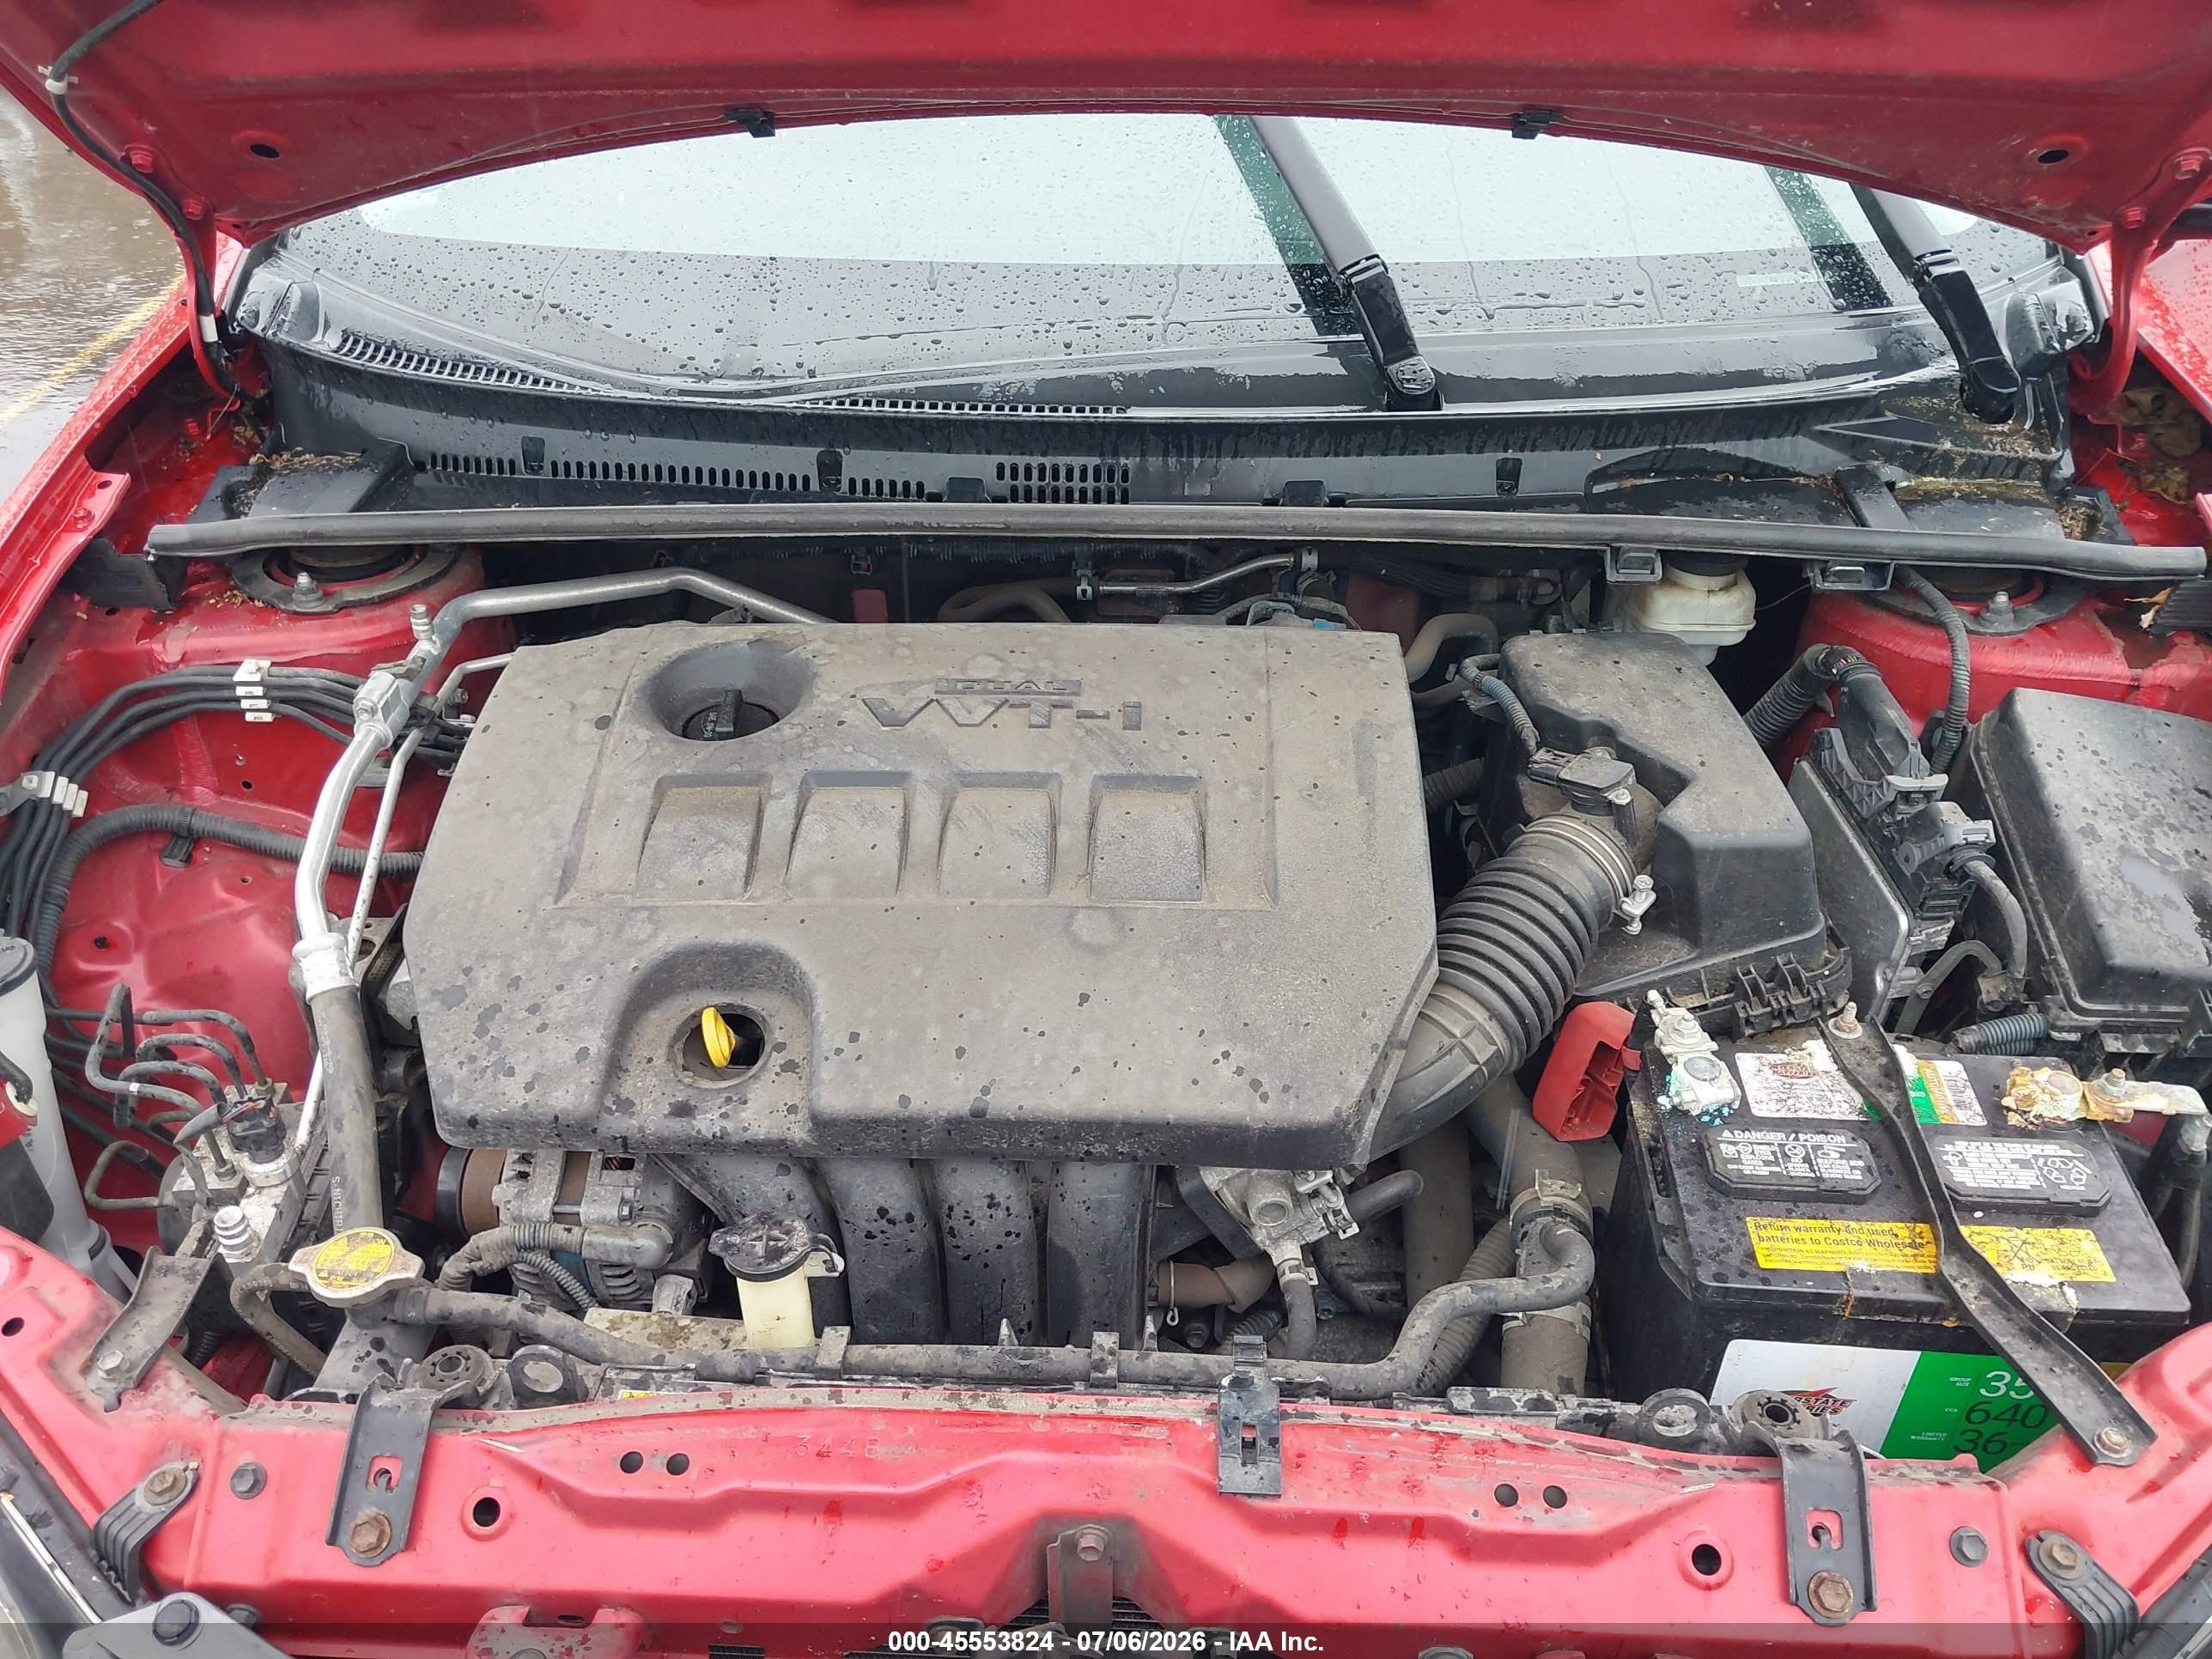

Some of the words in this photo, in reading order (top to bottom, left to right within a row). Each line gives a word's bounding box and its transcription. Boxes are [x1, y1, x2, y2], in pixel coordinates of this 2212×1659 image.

[1733, 1130, 1786, 1141] DANGER
[1798, 1133, 1846, 1143] POISON
[1754, 1222, 1790, 1232] Return
[1794, 1224, 1841, 1235] warranty
[1759, 1235, 1806, 1244] batteries
[1810, 1237, 1821, 1245] to
[1825, 1237, 1863, 1247] Costco
[1866, 1238, 1924, 1249] Wholesale
[1979, 1370, 2035, 1400] 35
[1965, 1401, 2049, 1429] 640
